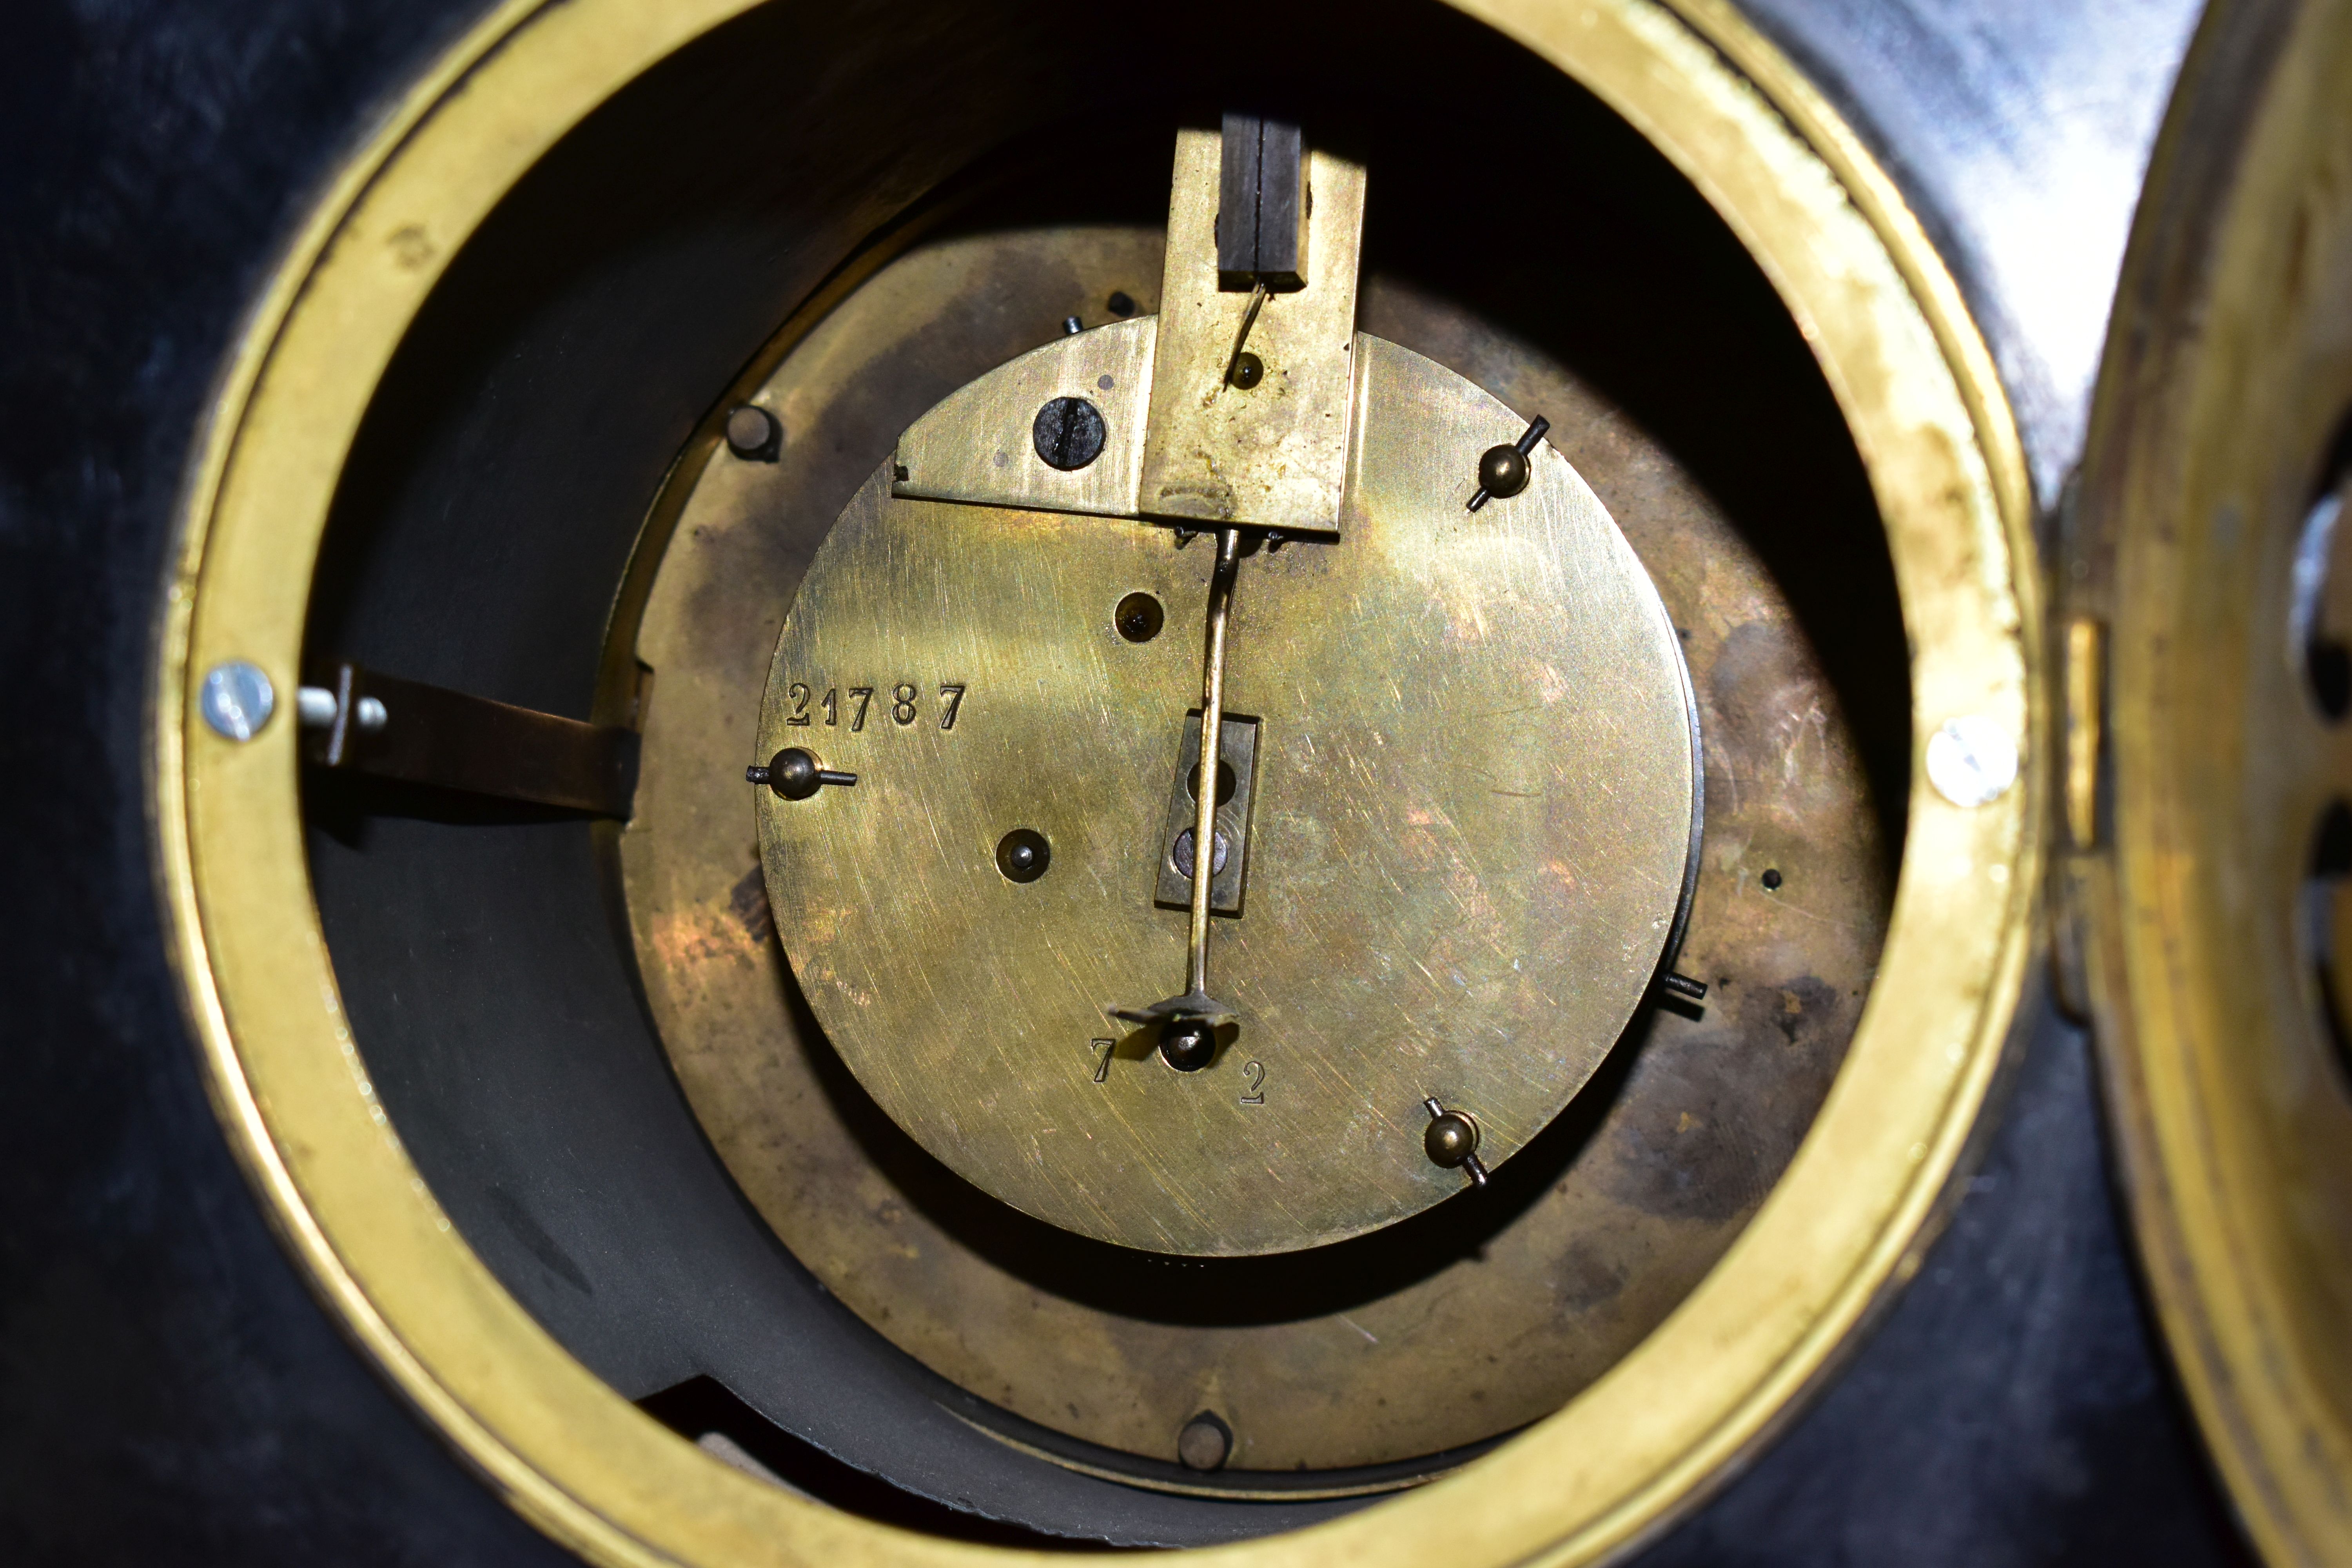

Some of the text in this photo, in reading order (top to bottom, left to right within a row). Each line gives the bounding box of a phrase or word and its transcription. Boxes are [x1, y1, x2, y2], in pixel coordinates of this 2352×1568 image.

[786, 682, 965, 731] 21787
[1091, 1038, 1265, 1104] 7 2
